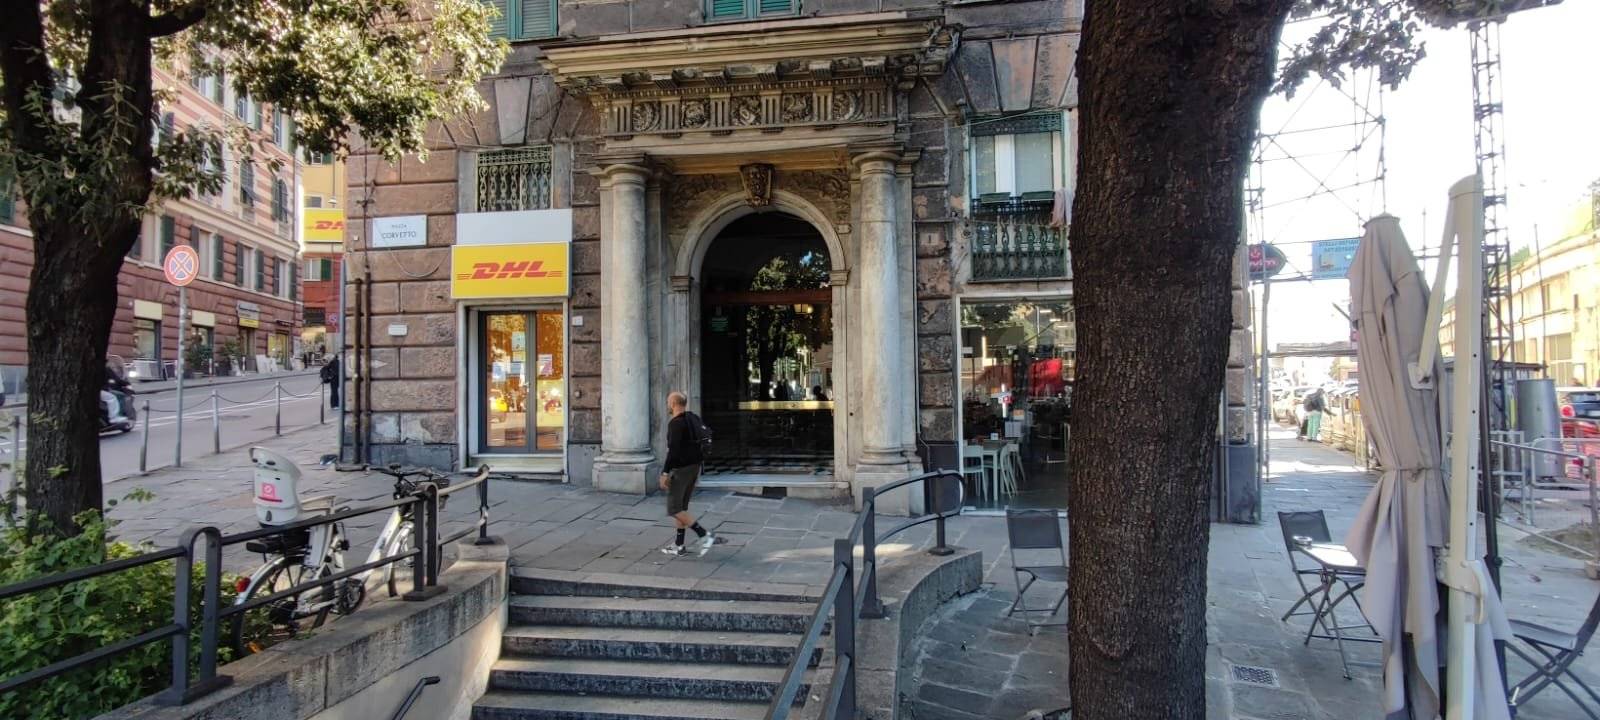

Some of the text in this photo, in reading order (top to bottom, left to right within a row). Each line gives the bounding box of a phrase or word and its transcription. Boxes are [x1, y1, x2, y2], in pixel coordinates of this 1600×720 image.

[314, 220, 344, 230] DH
[381, 230, 417, 239] CORVETTO
[471, 261, 548, 280] DHL
